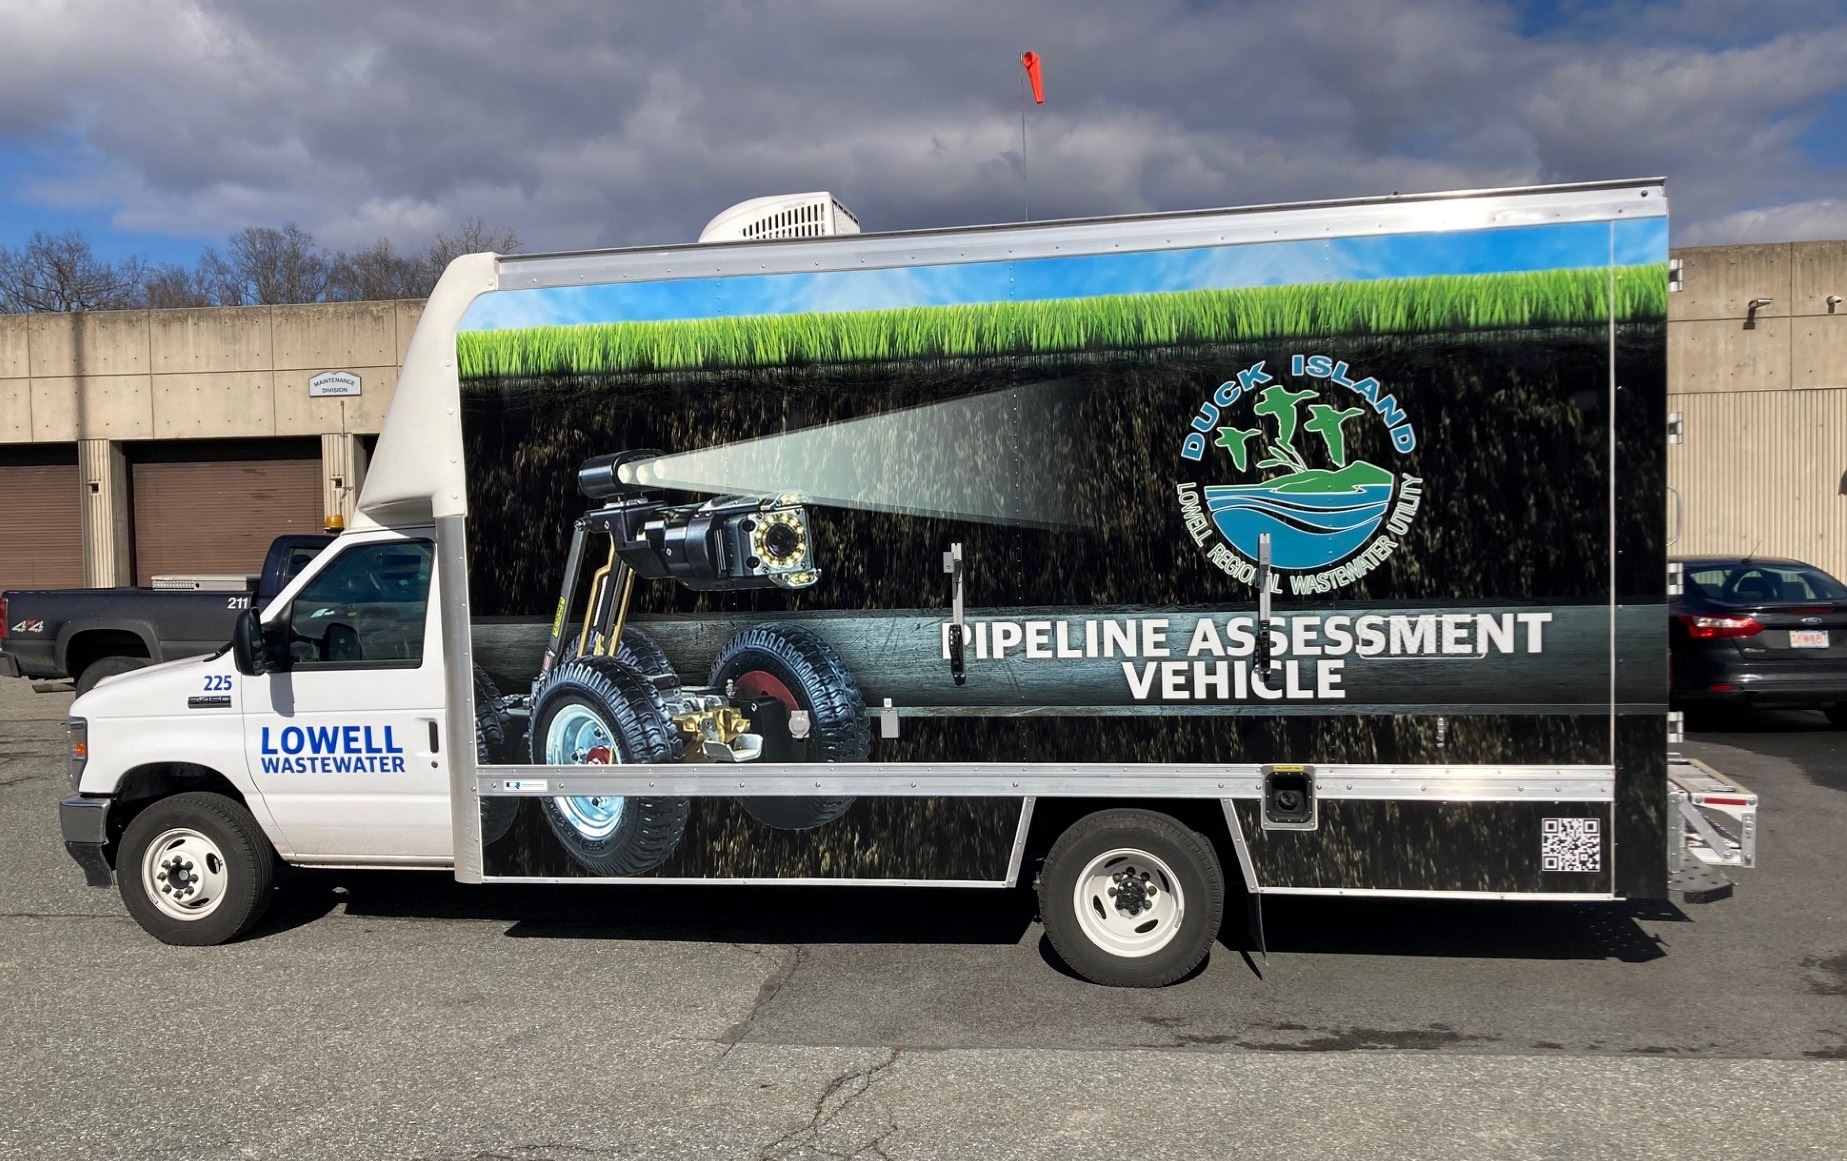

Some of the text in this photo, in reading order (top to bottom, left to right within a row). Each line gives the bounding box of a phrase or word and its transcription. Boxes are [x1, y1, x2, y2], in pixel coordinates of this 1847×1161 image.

[313, 377, 355, 387] MAINTENANCE
[1181, 354, 1417, 461] DUCK ISLAND
[1177, 472, 1424, 595] LOWELL REGIOL WASTEWATER UTILITY
[227, 597, 248, 609] 211
[1187, 612, 1553, 657] ASSESSMENT
[203, 675, 232, 691] 225
[1121, 659, 1346, 700] VEHICLE
[261, 725, 404, 755] LOWELL
[261, 756, 406, 774] WASTEWATER
